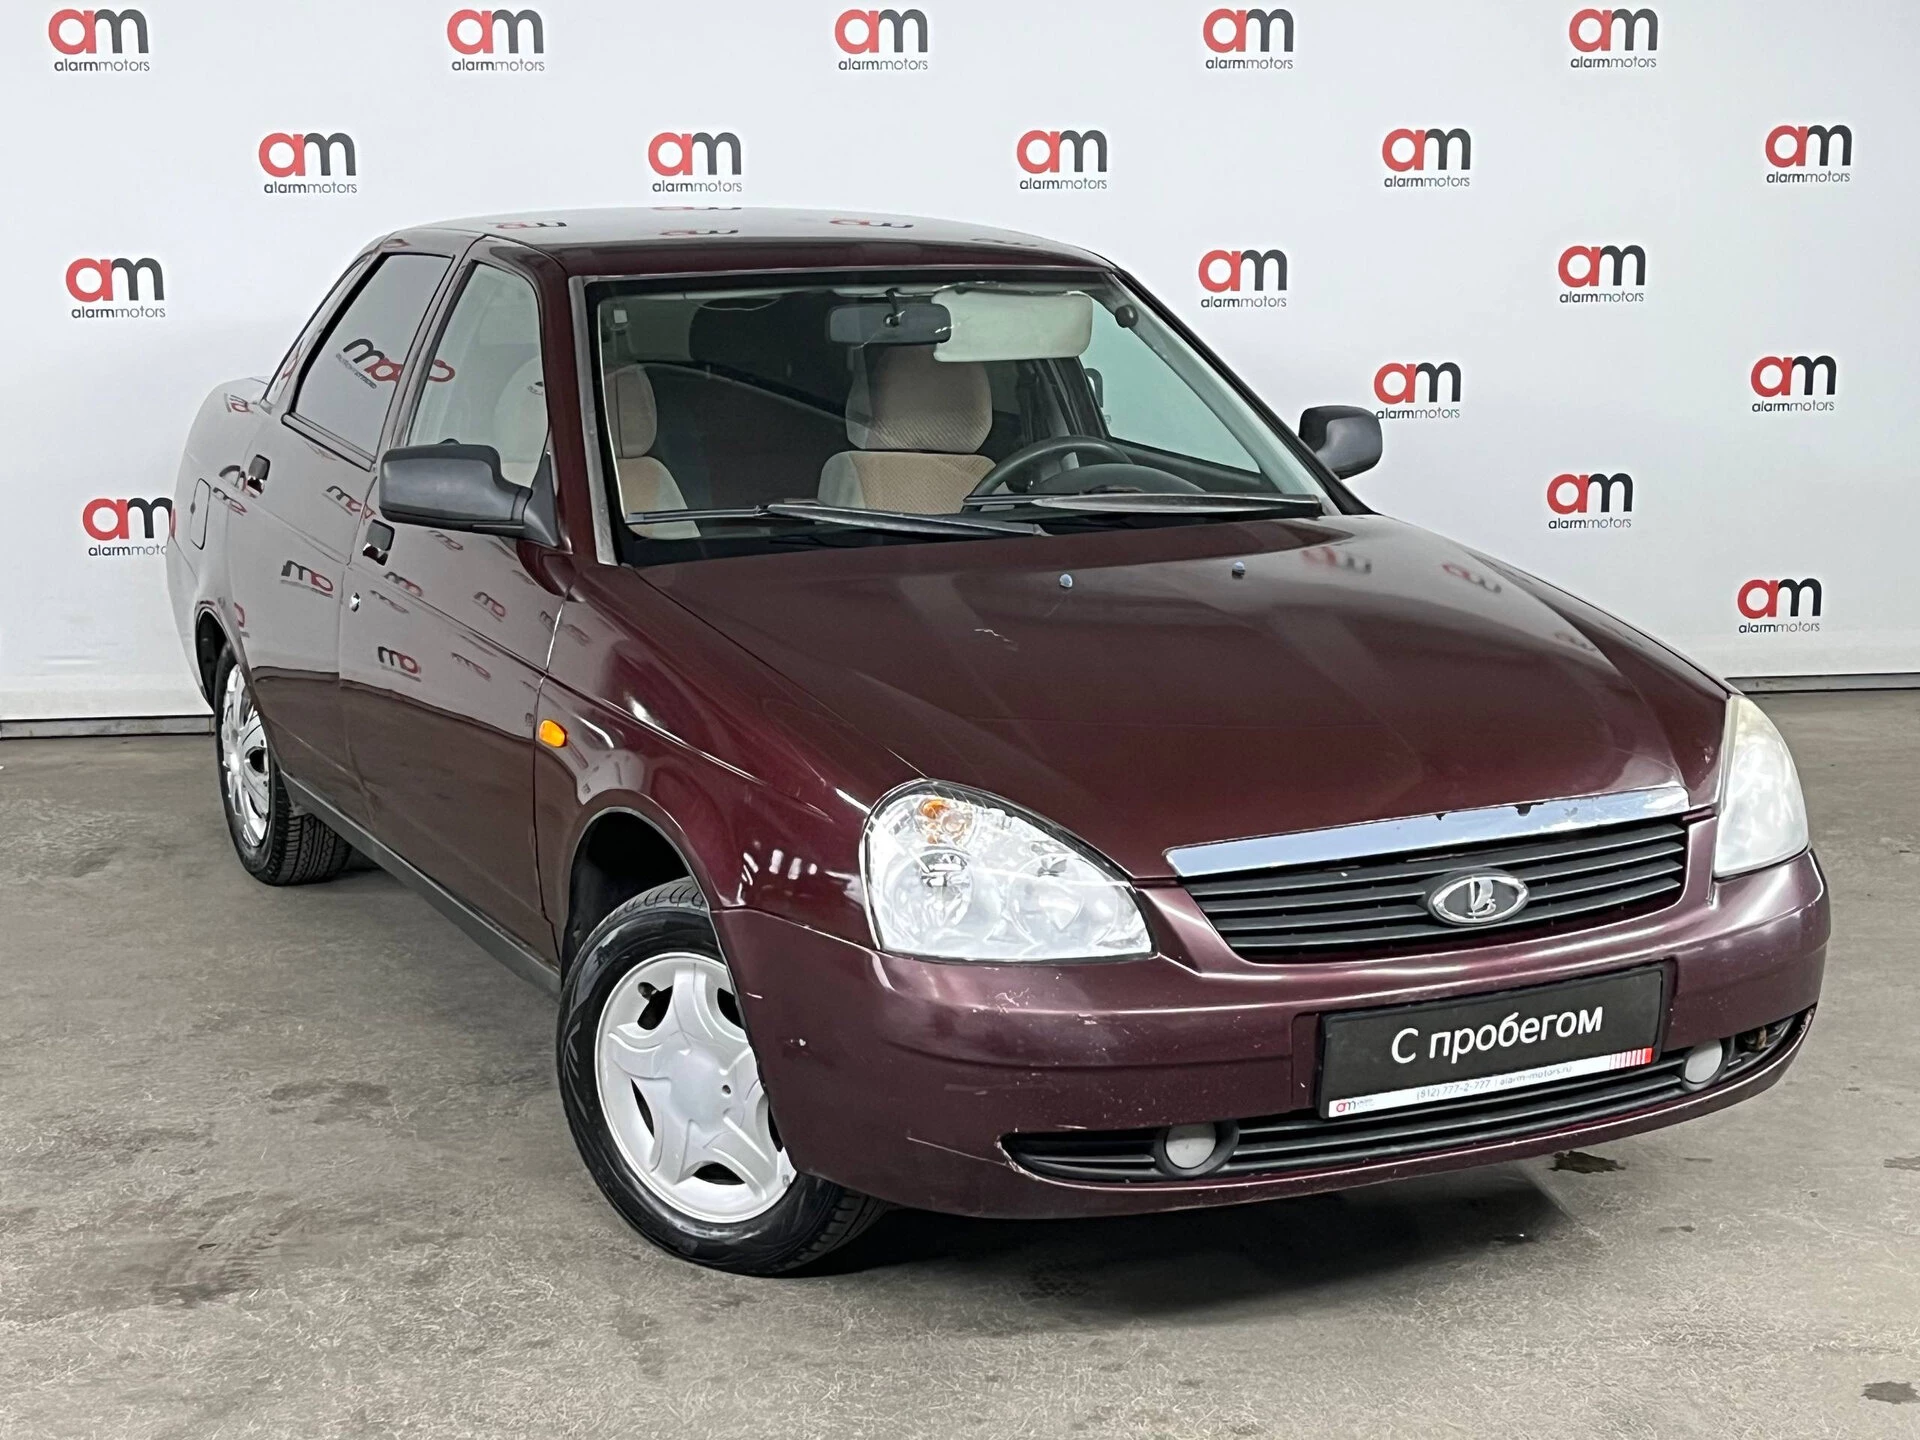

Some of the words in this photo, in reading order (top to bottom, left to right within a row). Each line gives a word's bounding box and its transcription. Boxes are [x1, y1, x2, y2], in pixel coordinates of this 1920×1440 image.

[48, 9, 149, 55] am
[447, 9, 544, 55] am
[835, 9, 928, 54] am
[1203, 9, 1294, 53] am
[1569, 9, 1658, 52] am
[54, 59, 150, 71] alarmmotors
[452, 58, 544, 71] alarmmotors
[838, 58, 928, 70] alarmmotors
[1206, 57, 1293, 69] alarmmotors
[1571, 56, 1656, 68] alarmmotors
[259, 133, 356, 177] am
[648, 132, 741, 176] am
[1017, 130, 1107, 174] am
[1382, 128, 1471, 172] am
[1765, 125, 1852, 168] am
[264, 181, 357, 193] alarmmotors
[652, 180, 742, 192] alarmmotors
[1020, 178, 1107, 189] alarmmotors
[1384, 175, 1469, 187] alarmmotors
[1766, 171, 1850, 183] alarmmotors
[66, 258, 164, 302] am
[1198, 249, 1287, 293] am
[1558, 245, 1645, 288] am
[71, 306, 165, 318] alarmmotors
[1201, 296, 1286, 308] alarmmotors
[1560, 291, 1644, 303] alarmmotors
[1374, 362, 1461, 404] am
[1751, 355, 1836, 397] am
[1376, 407, 1460, 419] alarmmotors
[1752, 400, 1834, 412] alarmmotors
[1547, 473, 1633, 514] am
[83, 497, 172, 540] am
[1548, 518, 1631, 529] alarmmotors
[1737, 578, 1822, 619] am
[1739, 622, 1819, 633] alarmmotors
[1391, 1027, 1419, 1064] С
[1429, 1006, 1603, 1064] пробегом
[1443, 1079, 1491, 1096] 777-2-777
